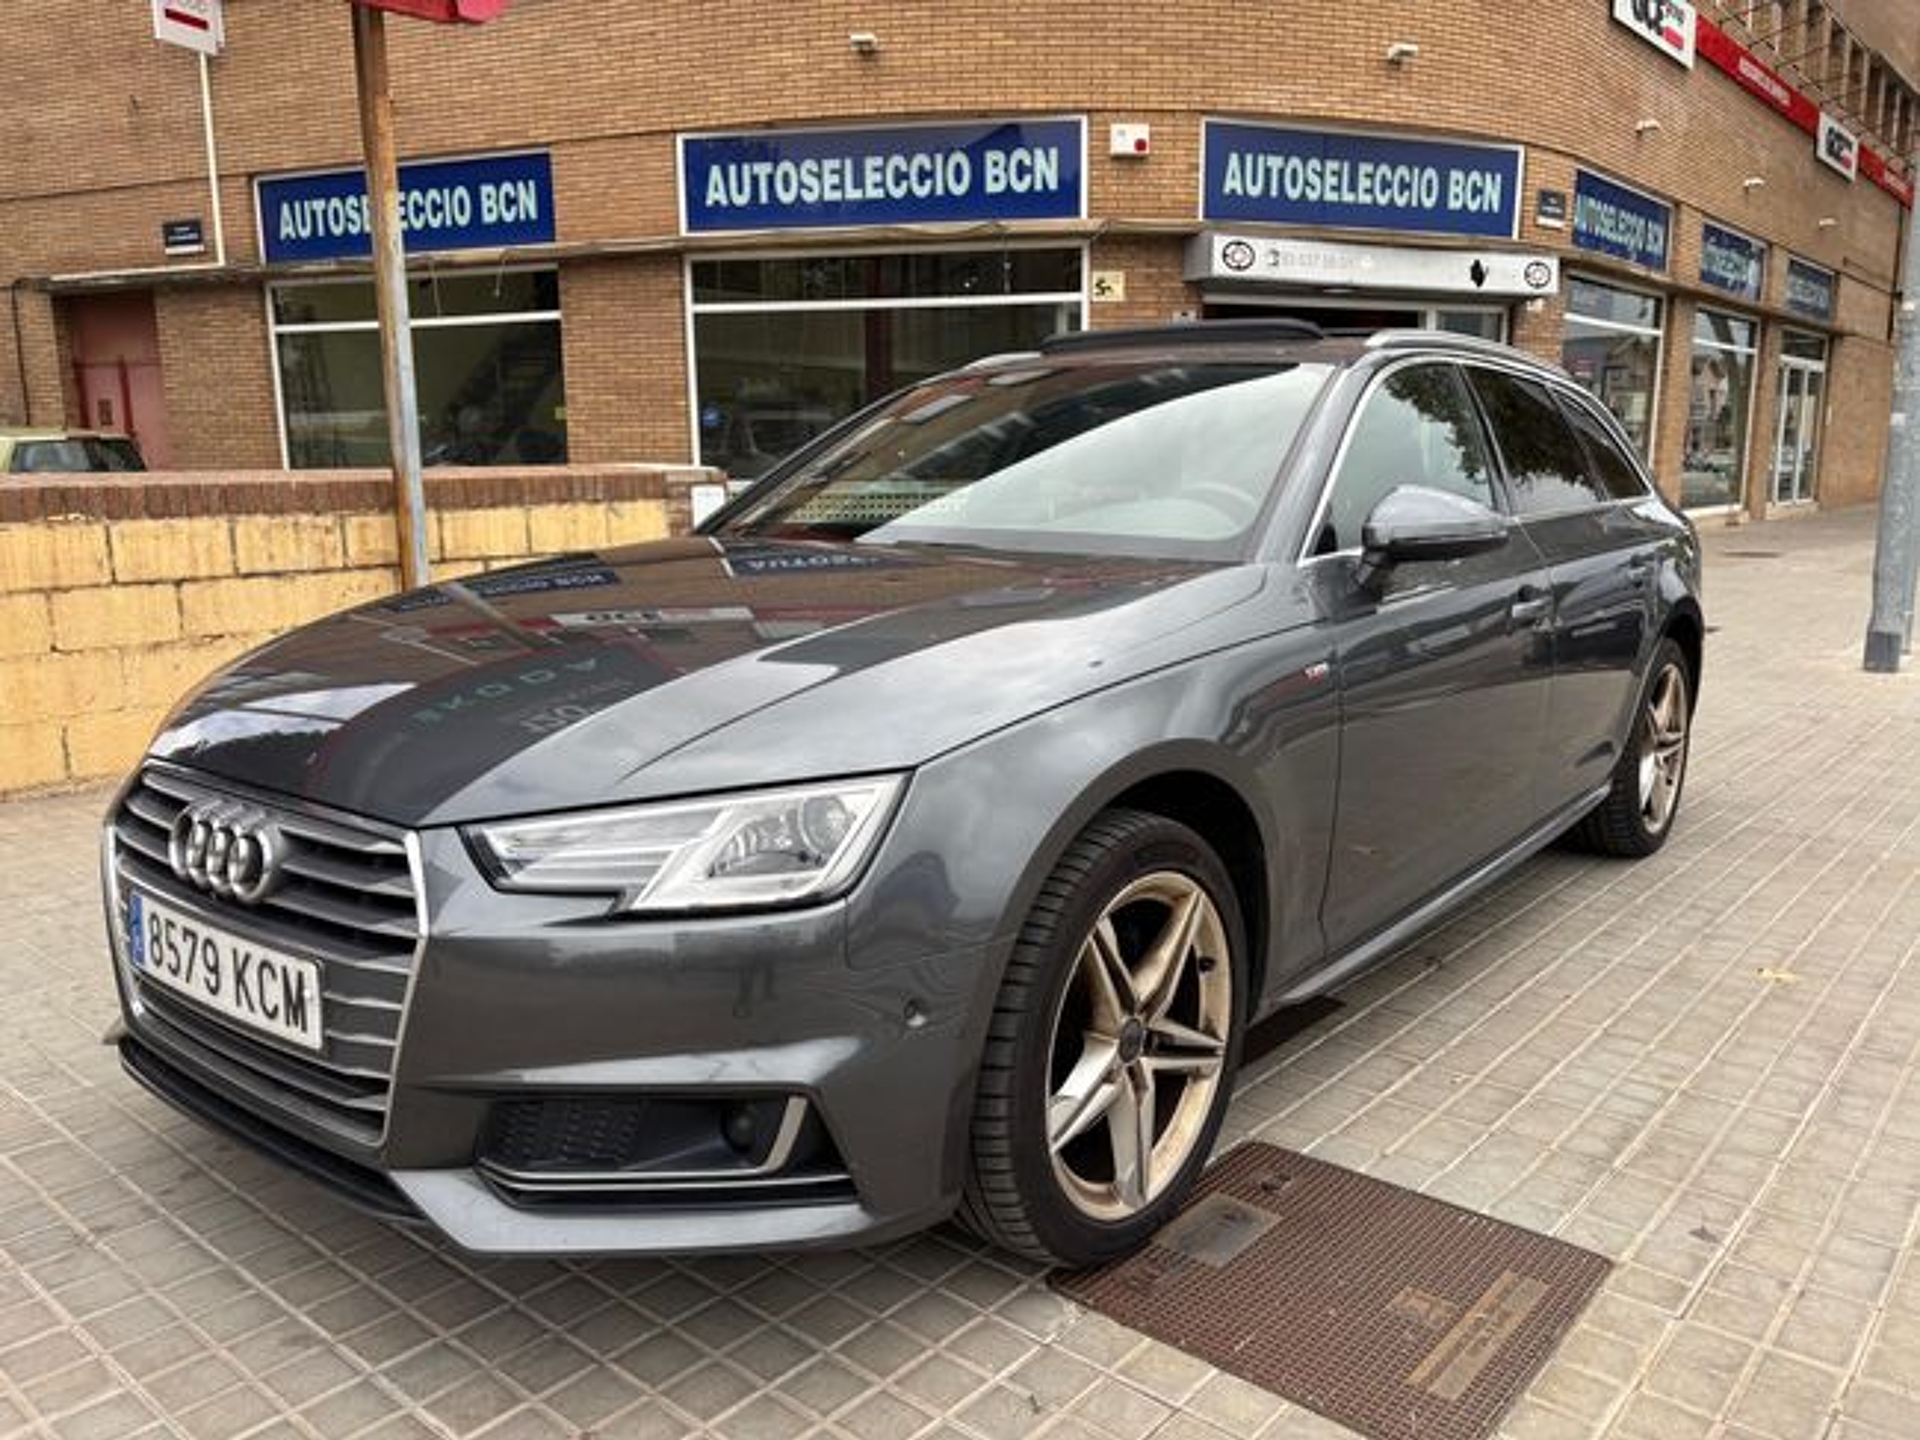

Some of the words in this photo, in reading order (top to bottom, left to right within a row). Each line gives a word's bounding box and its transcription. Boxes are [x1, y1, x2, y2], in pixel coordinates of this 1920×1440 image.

[705, 151, 971, 206] AUTOSELECCIO
[984, 146, 1059, 194] BCN
[1222, 151, 1439, 209] AUTOSELECCIO
[1446, 169, 1502, 214] BCN
[279, 186, 470, 241] AUTOSEECCIO
[478, 179, 538, 225] BCN
[148, 911, 221, 997] 8579
[231, 947, 308, 1034] KCM
